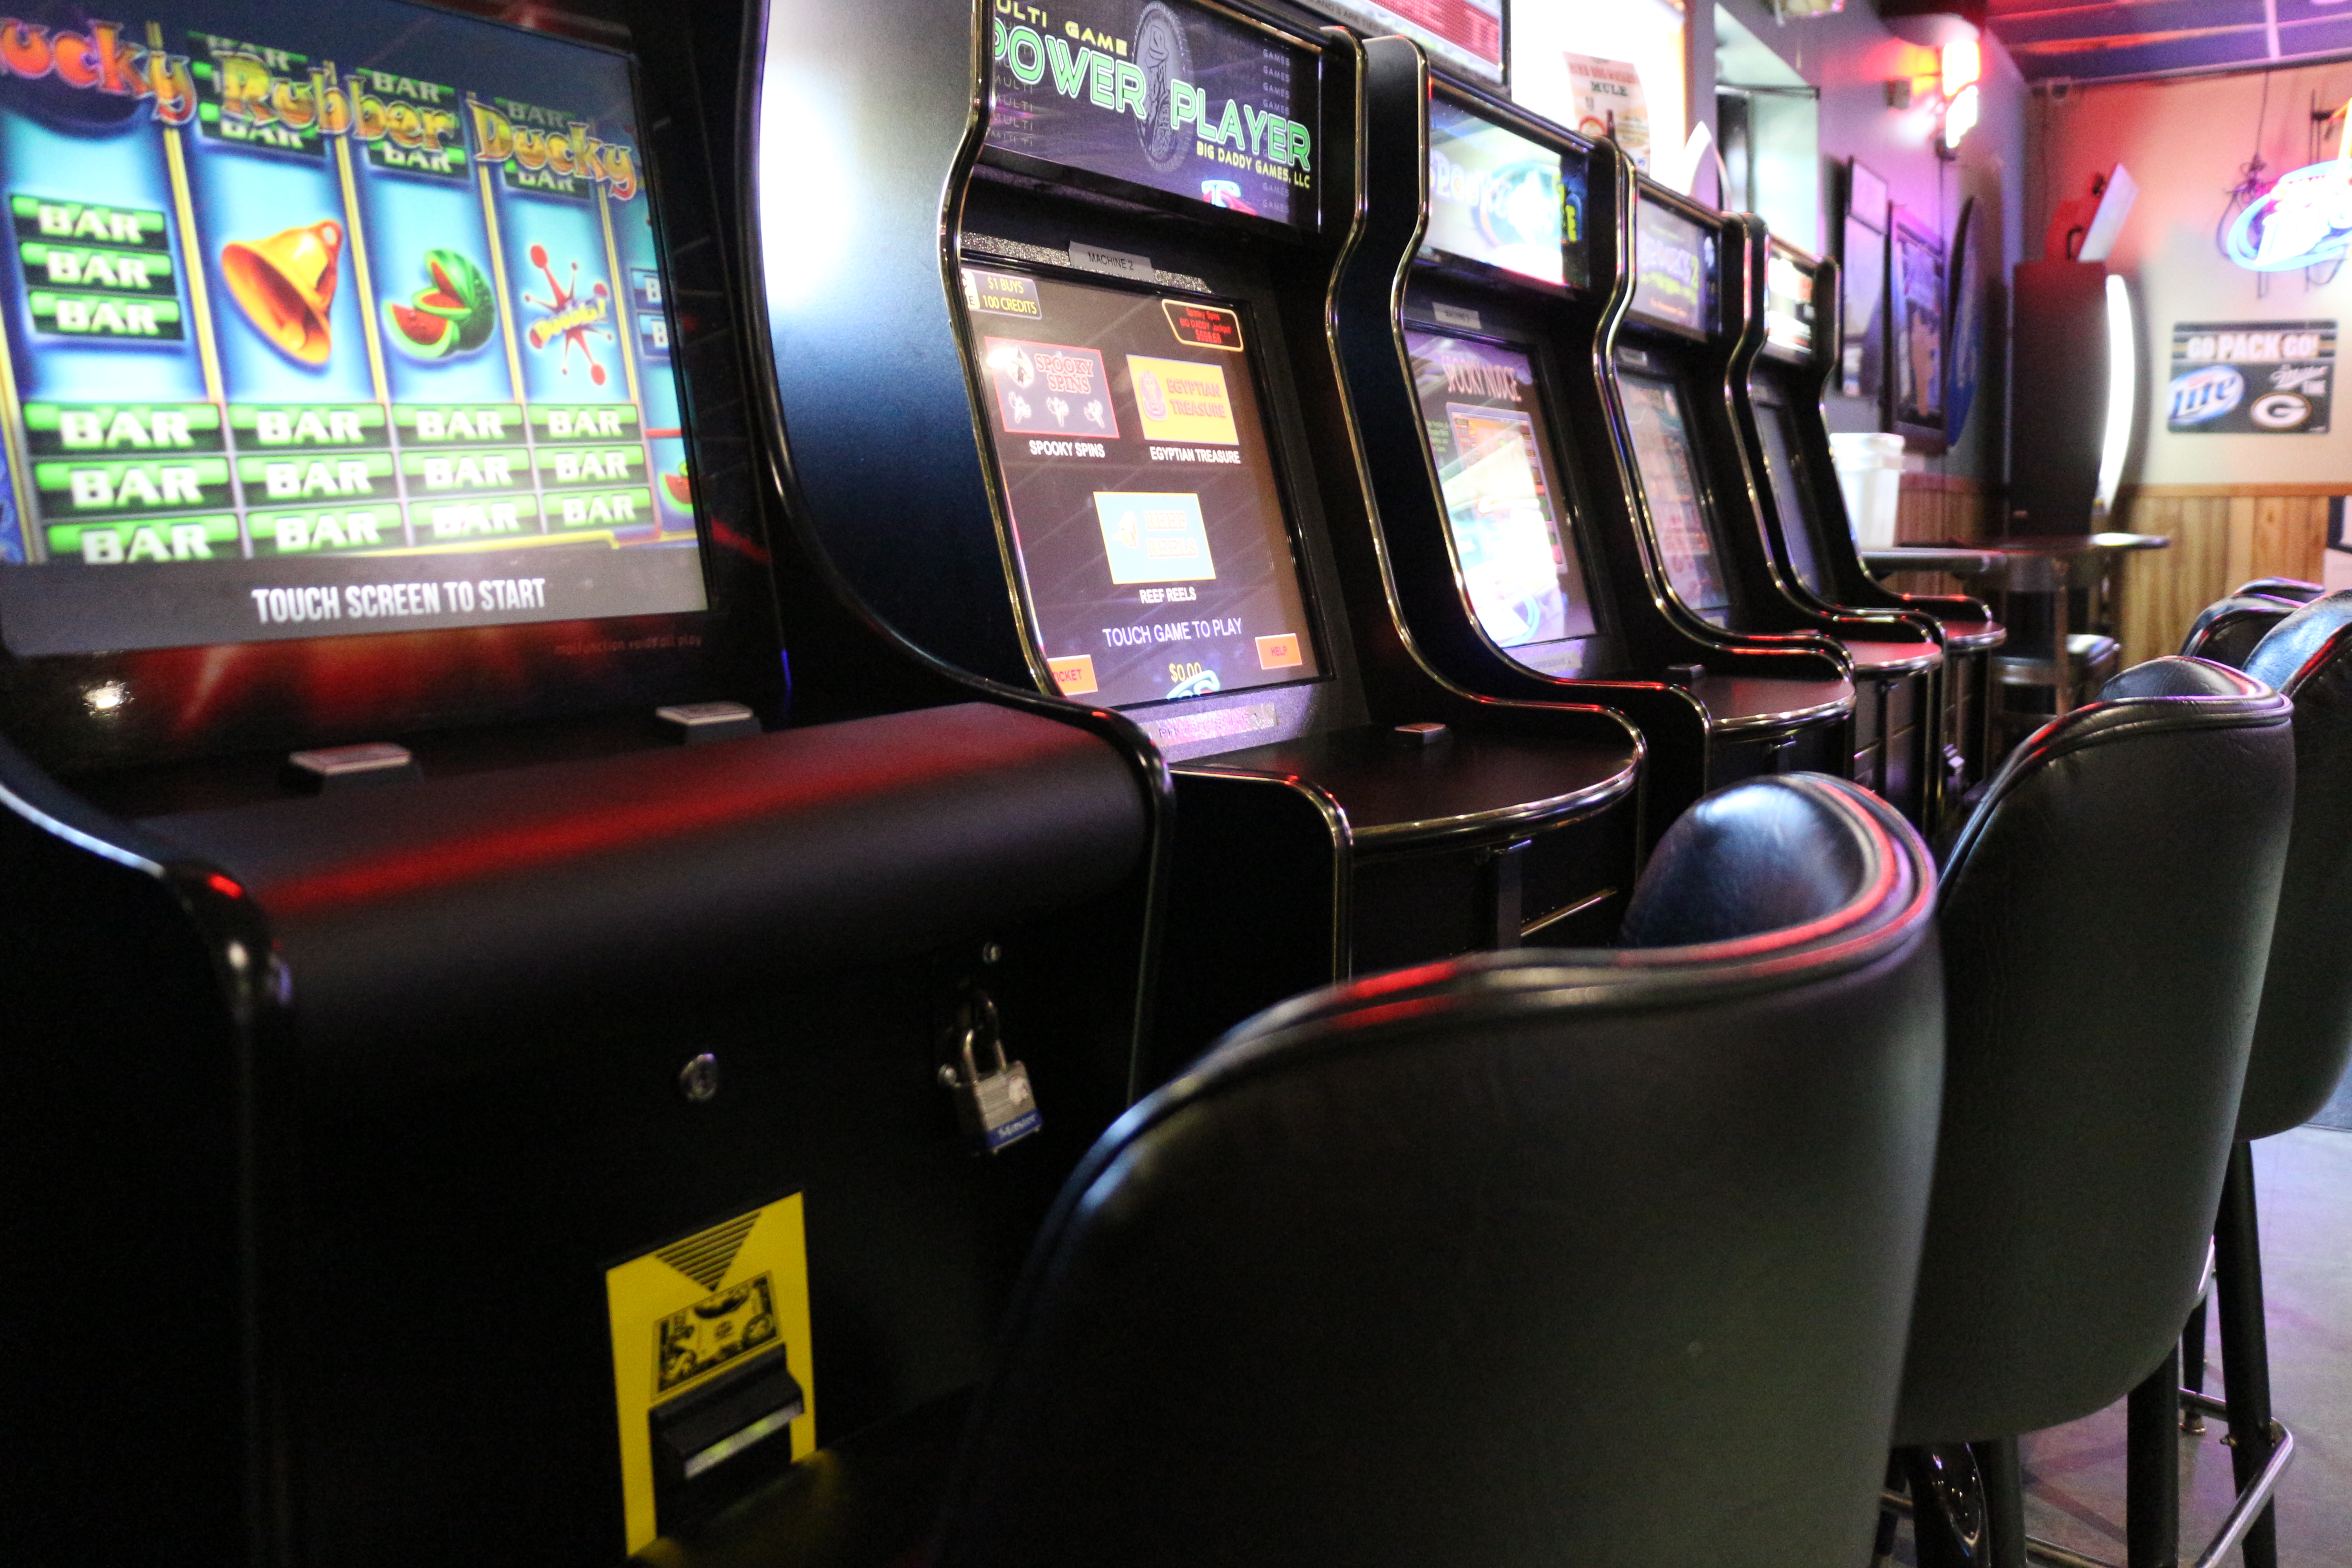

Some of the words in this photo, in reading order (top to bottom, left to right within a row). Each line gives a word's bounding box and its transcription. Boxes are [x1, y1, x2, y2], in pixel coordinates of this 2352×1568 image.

[996, 0, 1047, 27] ULTI
[1065, 21, 1127, 56] GAME
[1263, 49, 1290, 67] GAMES
[373, 71, 441, 103] BAR
[1263, 65, 1290, 83] GAMES
[1590, 80, 1627, 96] MULE
[1263, 82, 1290, 100] GAMES
[0, 17, 197, 126] ucky
[210, 50, 460, 152] Rubber
[466, 98, 637, 201] Ducky
[1171, 78, 1310, 172] PLAYER
[1196, 141, 1215, 160] BIG
[1218, 147, 1252, 170] DADDY
[1255, 160, 1291, 184] GAMES,
[1294, 171, 1310, 189] LLC
[38, 204, 144, 244] BAR
[47, 250, 152, 289] BAR
[1088, 252, 1127, 269] MACHINE
[1128, 260, 1133, 270] 2
[987, 275, 998, 290] $1
[1000, 278, 1024, 294] BUYS
[55, 299, 161, 336] BAR
[982, 294, 1000, 309] 100
[1000, 297, 1037, 315] CREDITS
[2187, 336, 2216, 359] GO
[2216, 333, 2281, 362] PACK
[2281, 334, 2321, 358] GO!
[1035, 353, 1093, 377] SPOOKY
[1047, 373, 1091, 394] SPINS
[1166, 377, 1221, 398] EGYPTIAN
[1170, 399, 1227, 418] TREASURE
[59, 410, 195, 449] BAR
[256, 410, 365, 445] BAR
[415, 409, 506, 441] BAR
[547, 410, 625, 438] BAR
[1029, 440, 1073, 457] SPOOKY
[1074, 442, 1106, 459] SPINS
[1149, 446, 1195, 462] EGYPTIAN
[1195, 448, 1241, 464] TREASURE
[265, 460, 374, 500] BAR
[423, 455, 514, 490] BAR
[554, 451, 631, 483] BAR
[69, 466, 204, 509] BAR
[431, 502, 521, 539] BAR
[562, 494, 637, 526] BAR
[1144, 510, 1187, 530] REEF
[82, 523, 214, 565] BAR
[274, 512, 382, 553] BAR
[1146, 538, 1198, 559] REELS
[251, 587, 340, 624] TOUCH
[346, 583, 441, 620] SCREEN
[443, 580, 475, 612] TO
[478, 577, 545, 611] START
[1139, 588, 1165, 604] REEF
[1166, 586, 1197, 602] REELS
[1102, 625, 1151, 647] TOUCH
[1153, 622, 1192, 642] GAME
[1191, 620, 1210, 639] TO
[1213, 617, 1243, 637] PLAY
[1270, 645, 1288, 657] HELP
[1169, 662, 1203, 683] $0.00
